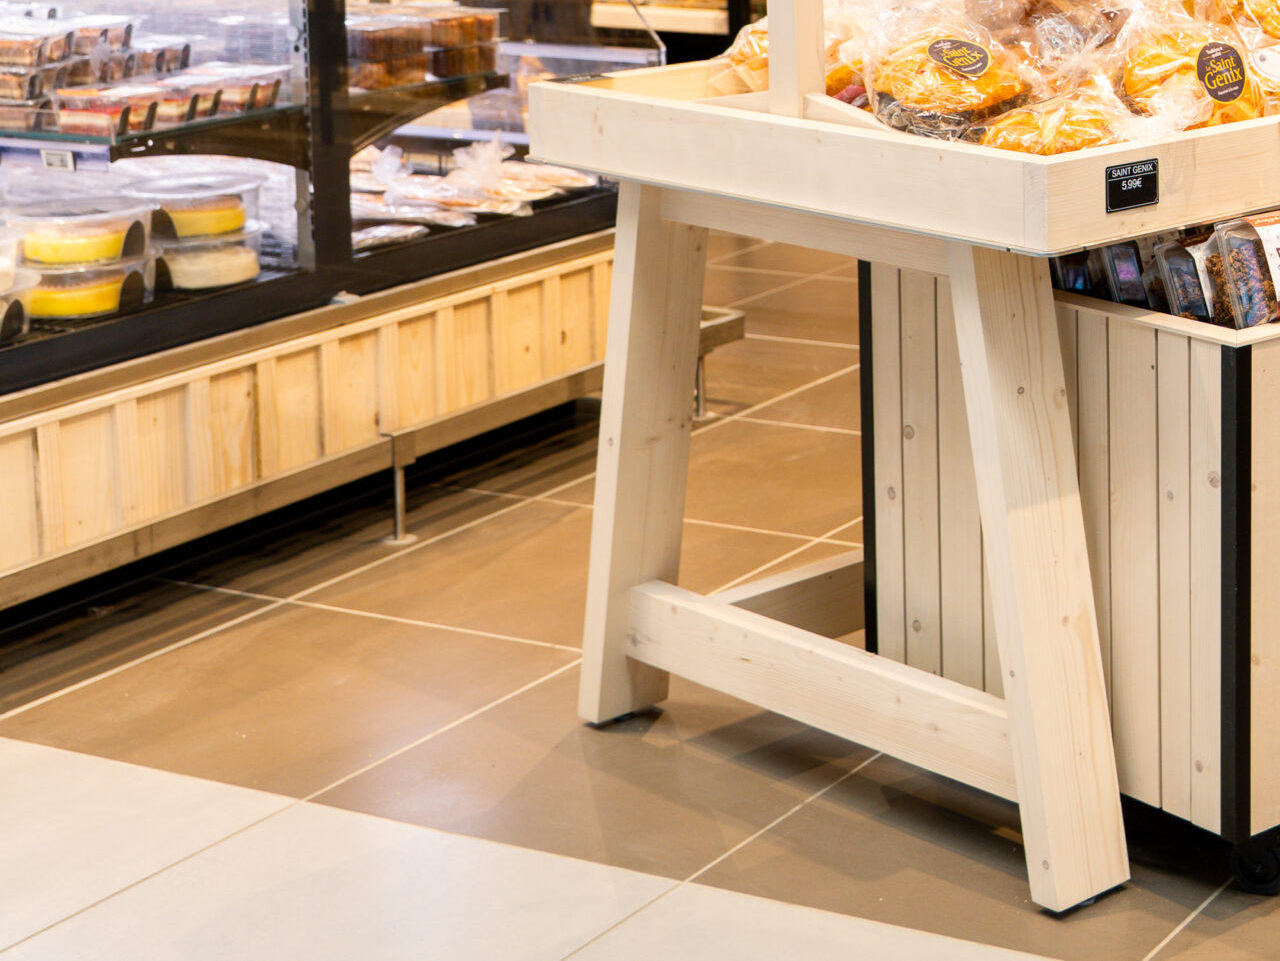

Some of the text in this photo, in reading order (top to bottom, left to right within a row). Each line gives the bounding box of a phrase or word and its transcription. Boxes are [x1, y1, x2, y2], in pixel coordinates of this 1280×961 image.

[1210, 56, 1236, 73] Saint
[1204, 68, 1243, 89] Genix
[1111, 163, 1154, 178] SAINT GENIX
